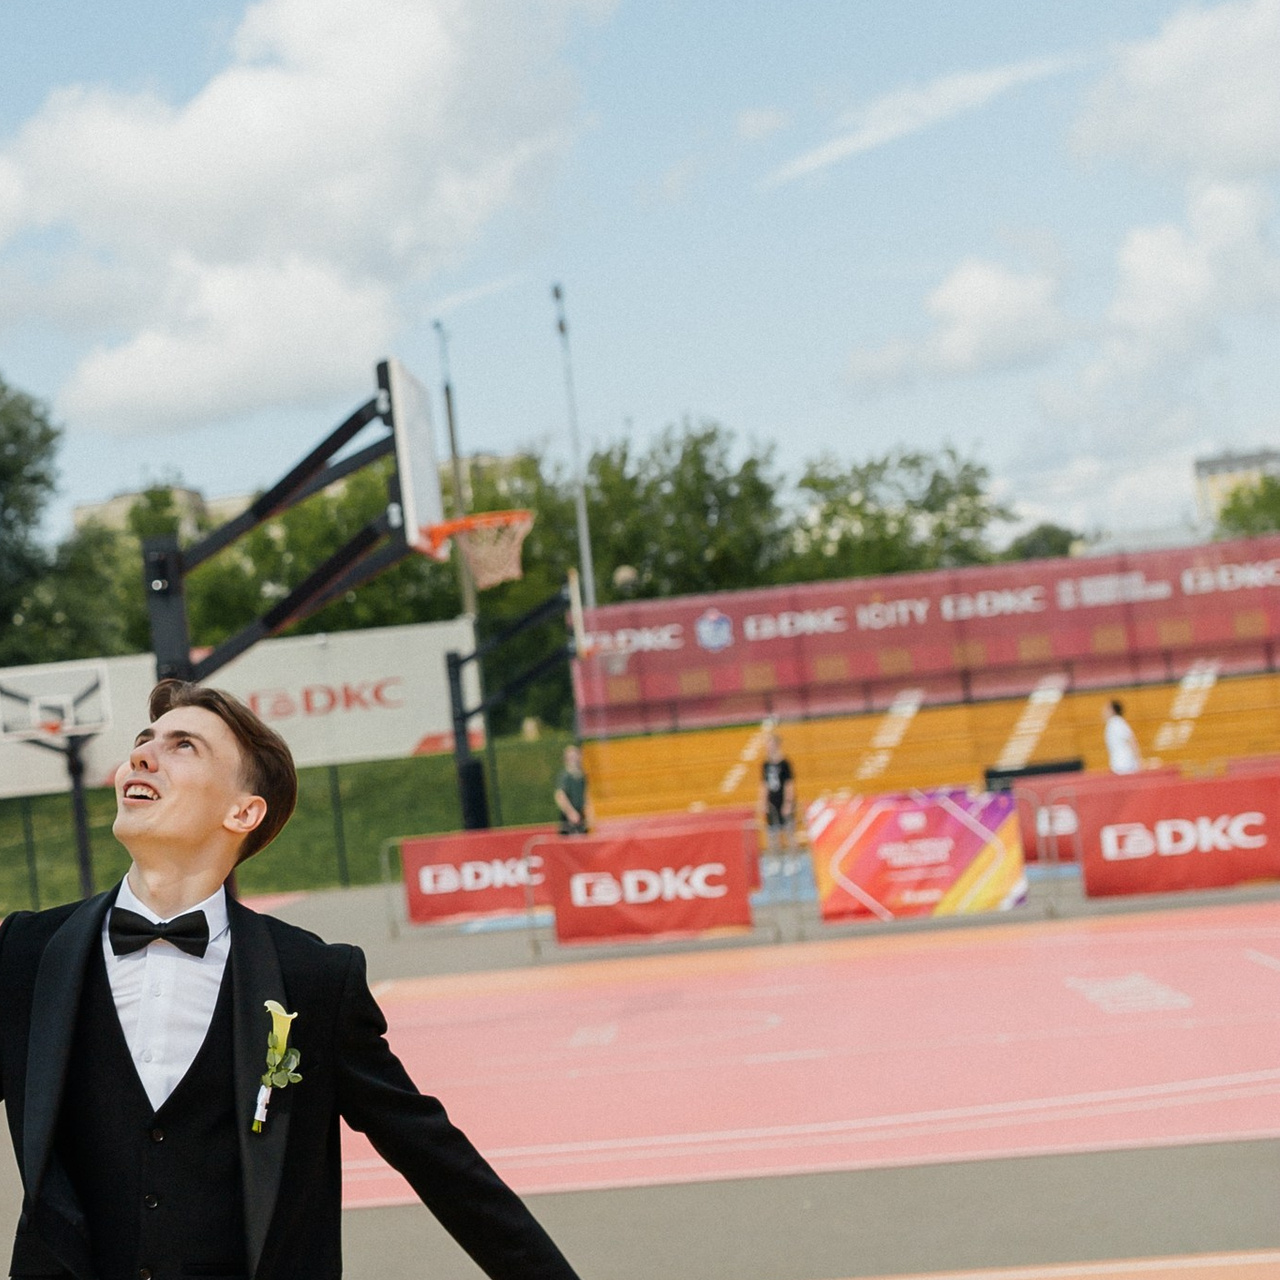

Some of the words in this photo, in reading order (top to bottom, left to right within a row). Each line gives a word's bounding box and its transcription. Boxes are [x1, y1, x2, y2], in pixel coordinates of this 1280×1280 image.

[302, 676, 404, 717] DKC
[1155, 811, 1268, 856] DKC
[460, 856, 545, 891] DKC
[621, 863, 728, 904] DKC
